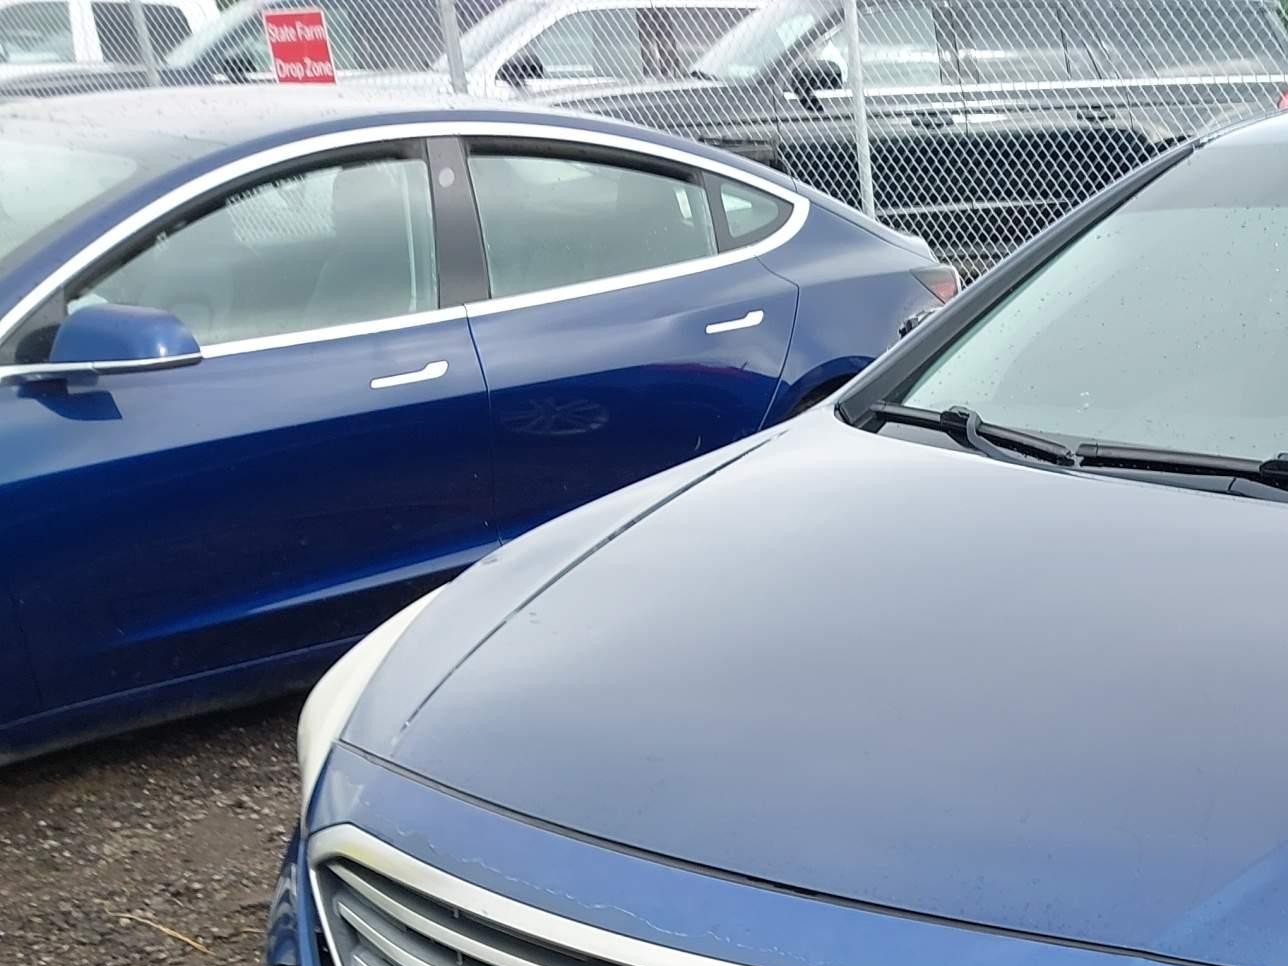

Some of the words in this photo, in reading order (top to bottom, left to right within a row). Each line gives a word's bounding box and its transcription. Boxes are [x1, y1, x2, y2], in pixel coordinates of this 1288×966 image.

[267, 23, 296, 42] State
[295, 21, 325, 41] Farm
[275, 58, 304, 80] Drop
[304, 57, 332, 77] Zone
